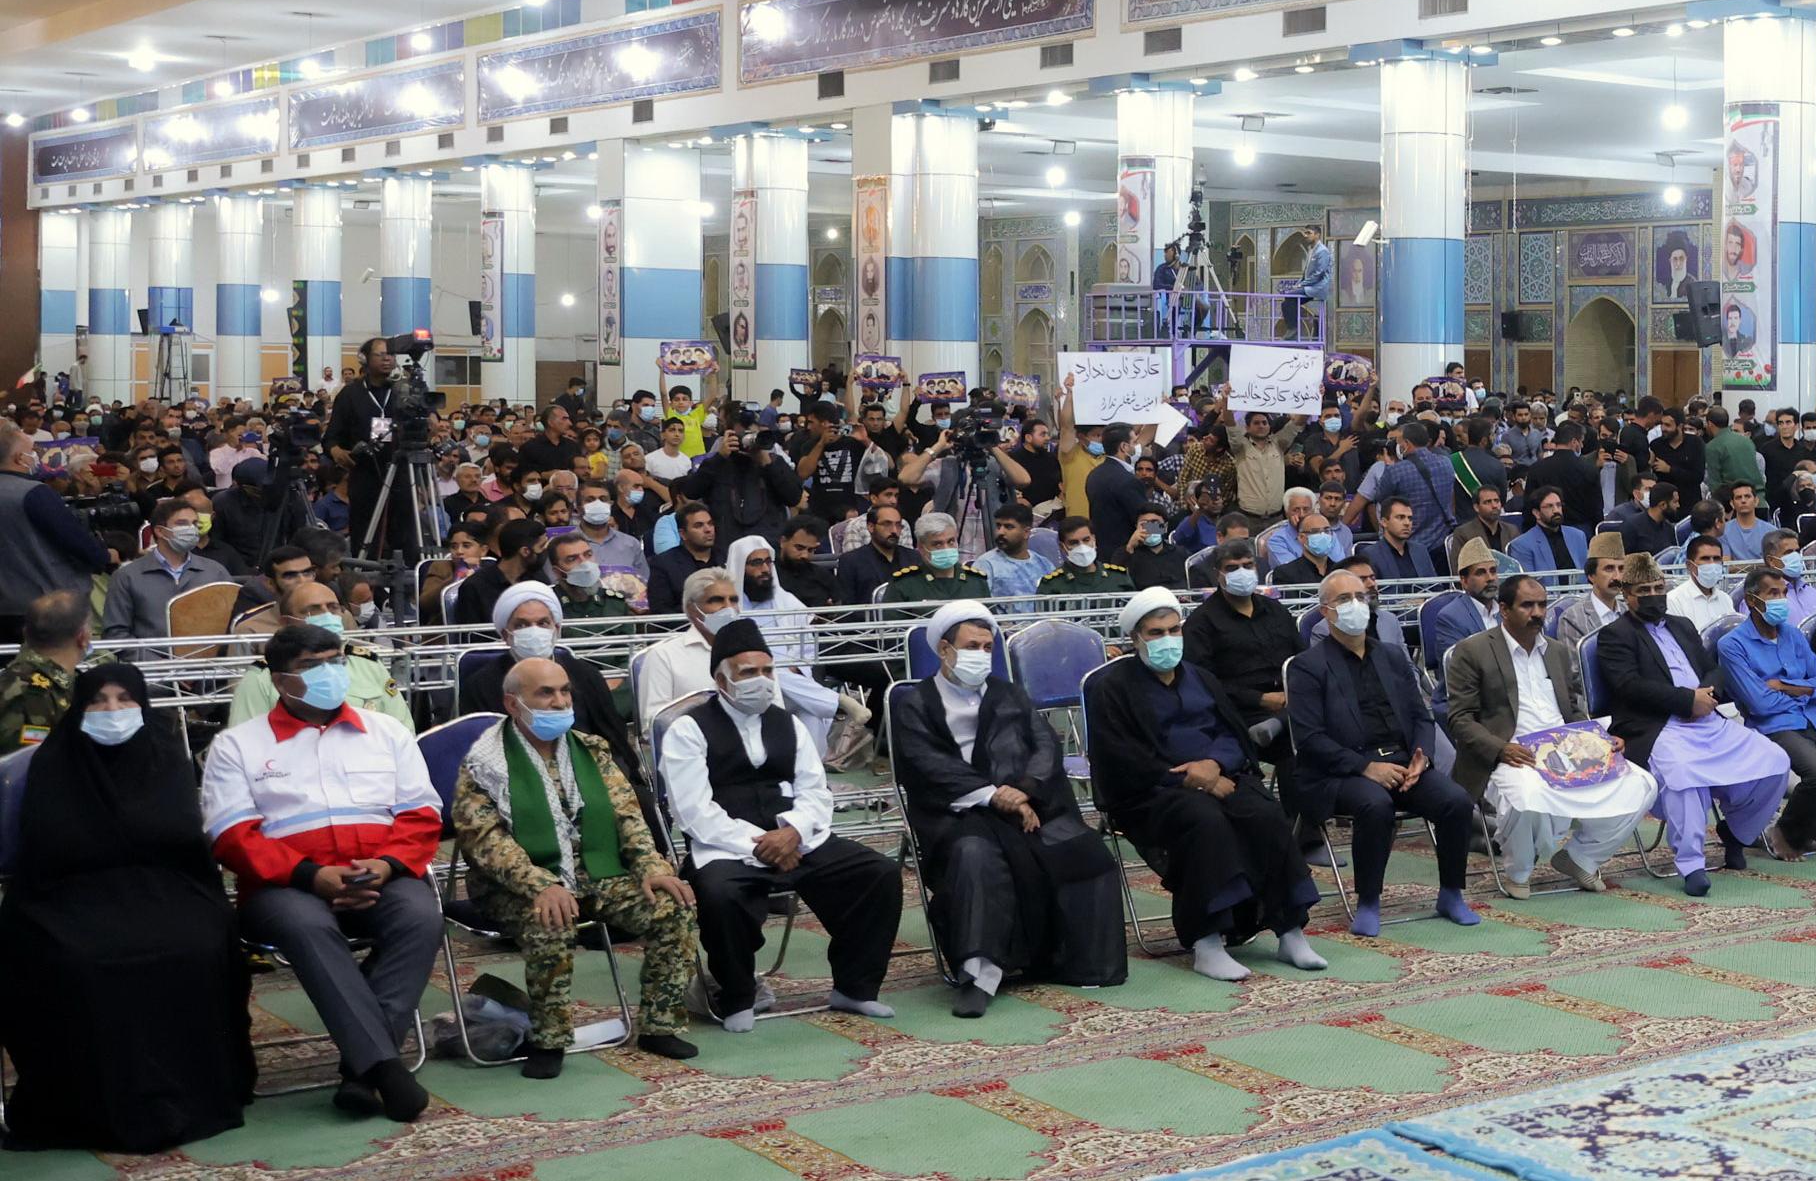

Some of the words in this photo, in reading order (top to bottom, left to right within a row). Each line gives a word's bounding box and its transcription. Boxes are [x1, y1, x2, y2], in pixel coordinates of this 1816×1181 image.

[1075, 356, 1105, 383] ندارد
[1106, 355, 1128, 380] نان
[1127, 356, 1160, 379] کارگر
[1100, 389, 1136, 421] شغلی
[1132, 395, 1158, 412] امنیت
[1256, 384, 1290, 407] کارگر
